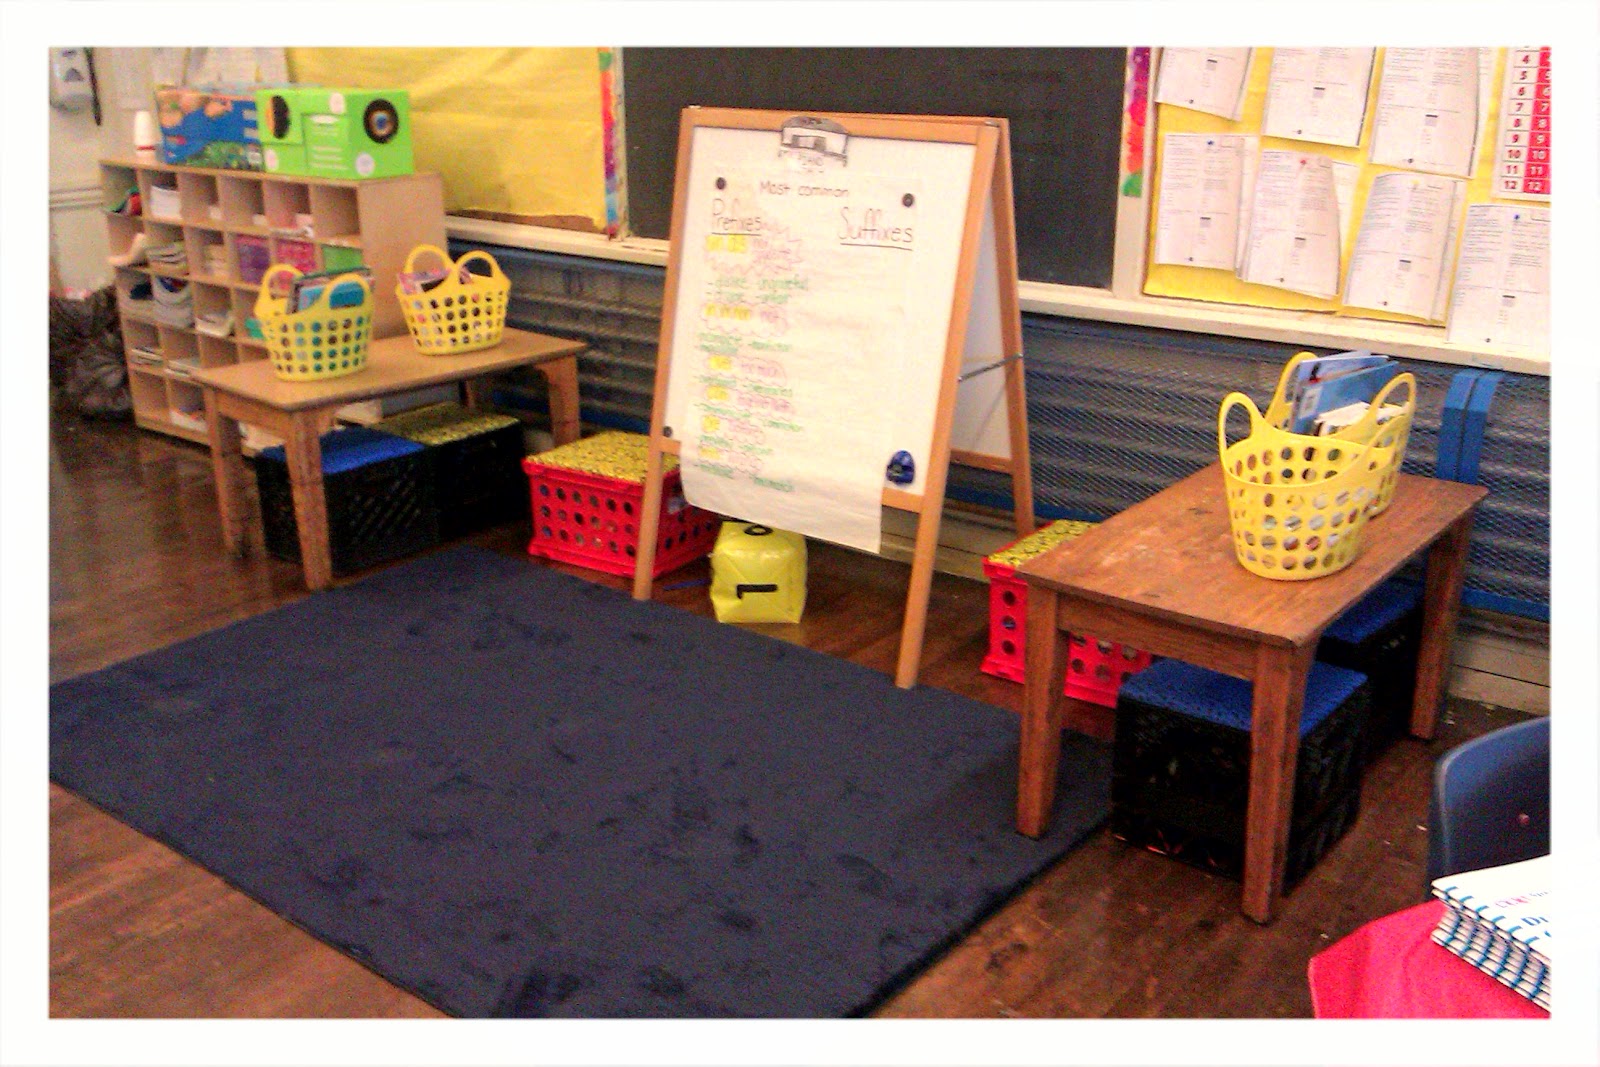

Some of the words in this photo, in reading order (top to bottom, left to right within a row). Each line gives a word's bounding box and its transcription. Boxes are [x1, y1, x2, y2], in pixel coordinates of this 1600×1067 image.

[1522, 54, 1529, 64] 4
[1520, 70, 1527, 80] 5
[1518, 86, 1525, 96] 6
[1515, 102, 1524, 112] 7
[1514, 118, 1521, 128] 8
[1512, 134, 1519, 143] 9
[1508, 149, 1521, 159] 10
[1506, 165, 1518, 174] 11
[759, 180, 790, 195] Most
[798, 185, 849, 198] common
[1504, 180, 1518, 190] 12
[711, 198, 762, 231] Prefixes
[838, 206, 913, 243] Suffixes
